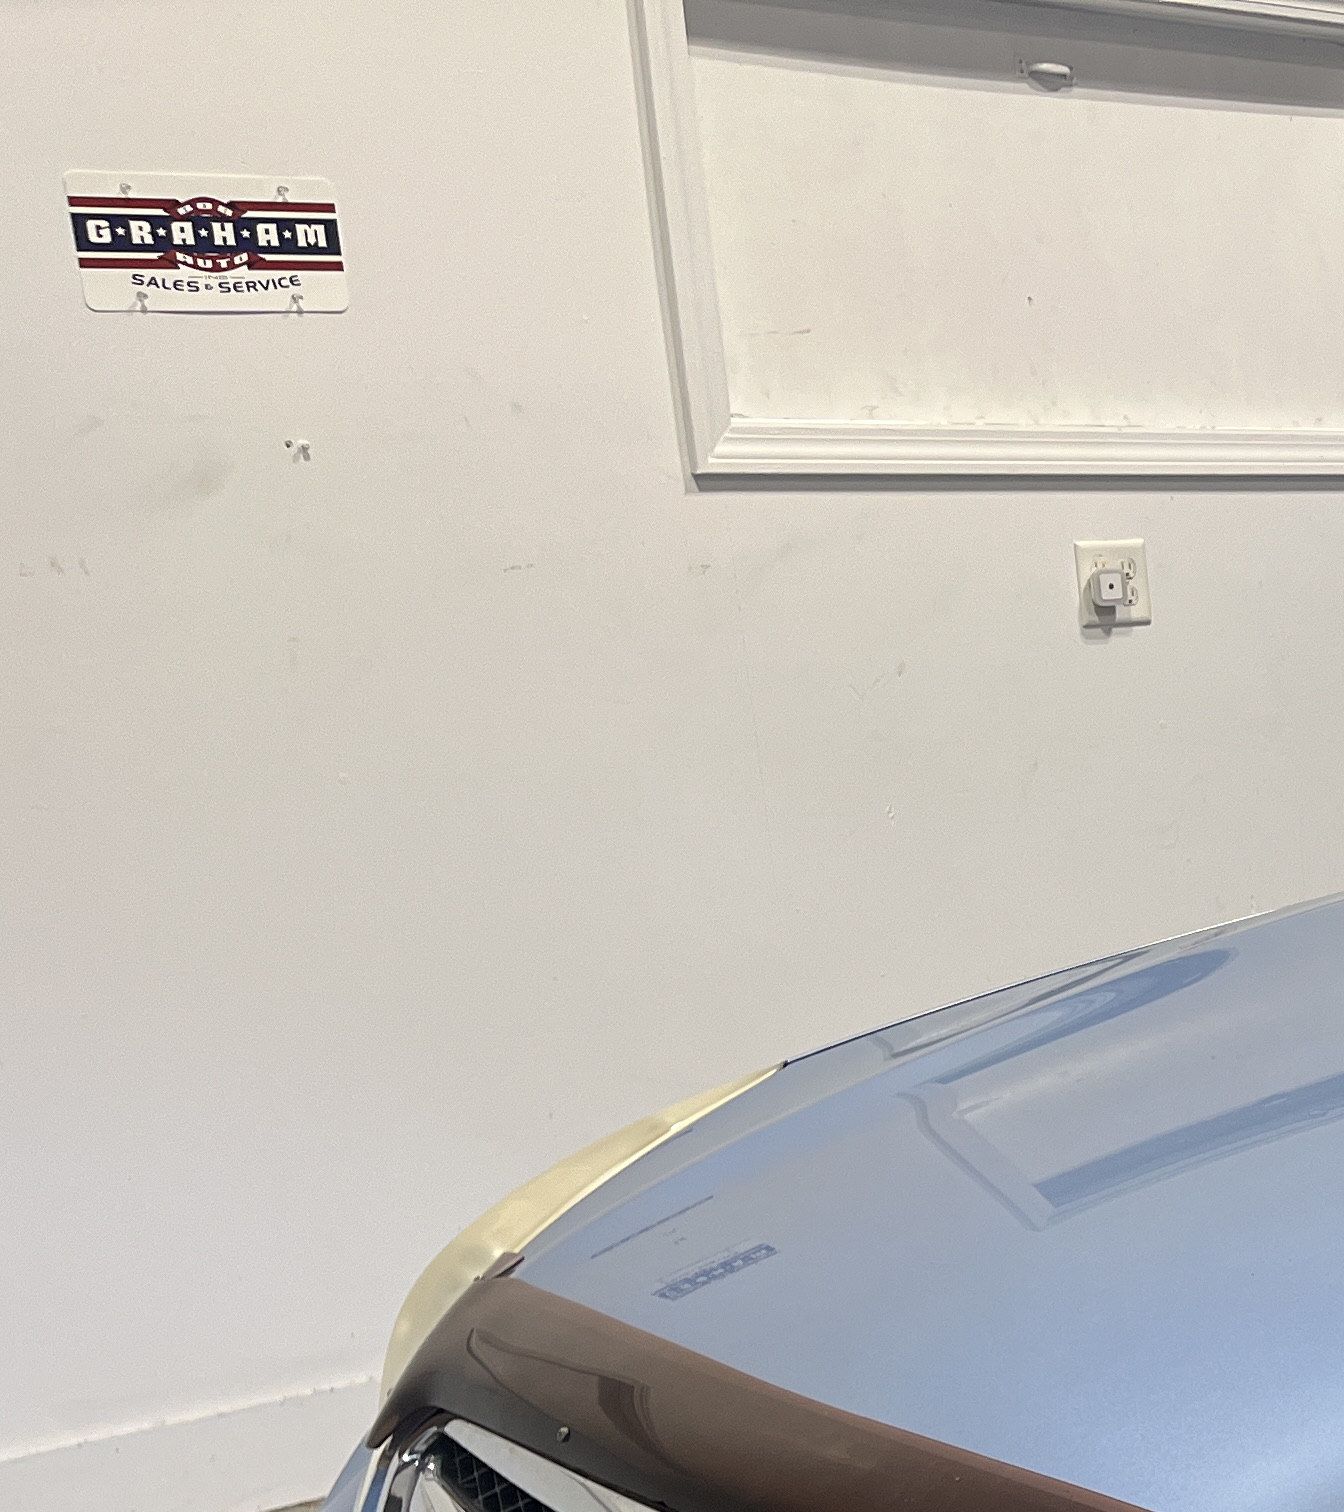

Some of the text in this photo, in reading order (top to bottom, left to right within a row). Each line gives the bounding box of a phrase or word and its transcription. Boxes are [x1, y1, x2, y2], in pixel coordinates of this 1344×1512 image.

[85, 218, 329, 248] GRAHAM
[176, 252, 249, 269] AUTO
[131, 273, 200, 293] SALES
[218, 274, 302, 293] SERVICE
